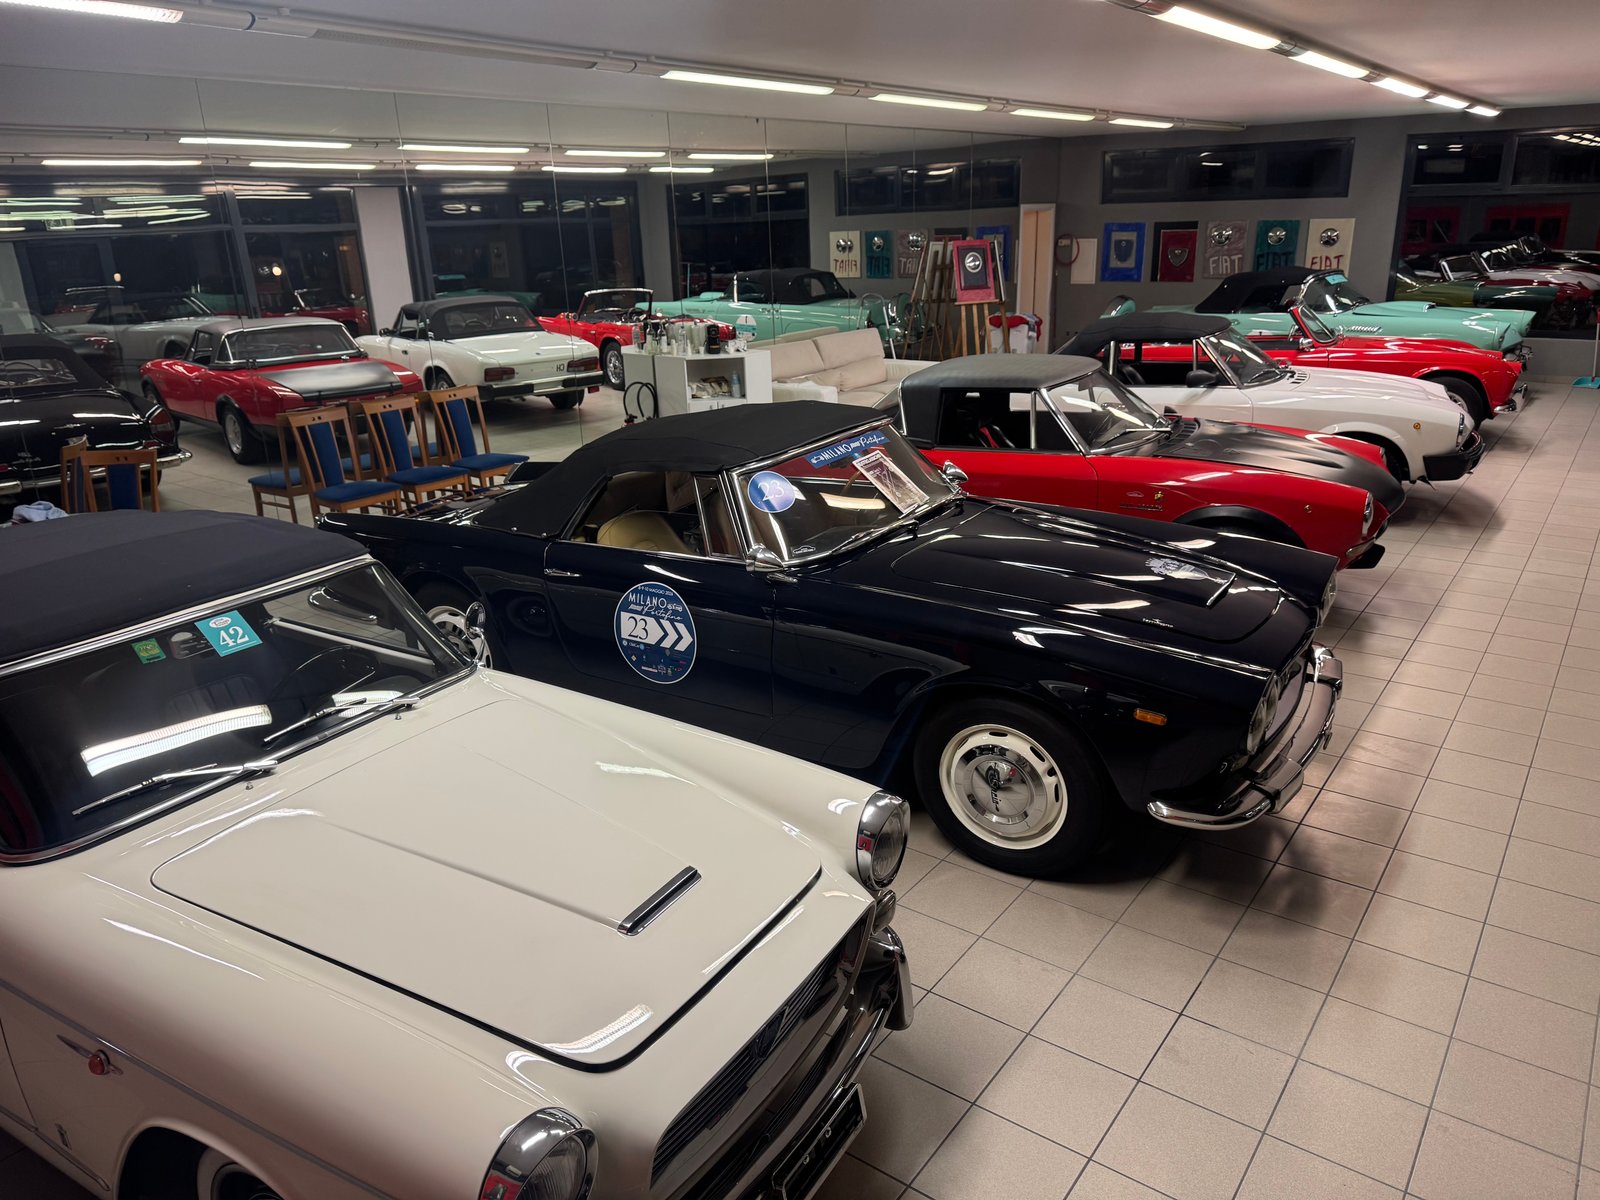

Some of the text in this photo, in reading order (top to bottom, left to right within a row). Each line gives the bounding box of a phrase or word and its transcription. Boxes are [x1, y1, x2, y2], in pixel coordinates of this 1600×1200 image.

[1209, 255, 1242, 275] FIAT
[1310, 255, 1344, 270] FIAT
[821, 443, 852, 460] MILANO
[758, 480, 784, 501] 23
[628, 592, 667, 609] MILANO
[219, 626, 250, 647] 42
[627, 616, 649, 640] 23
